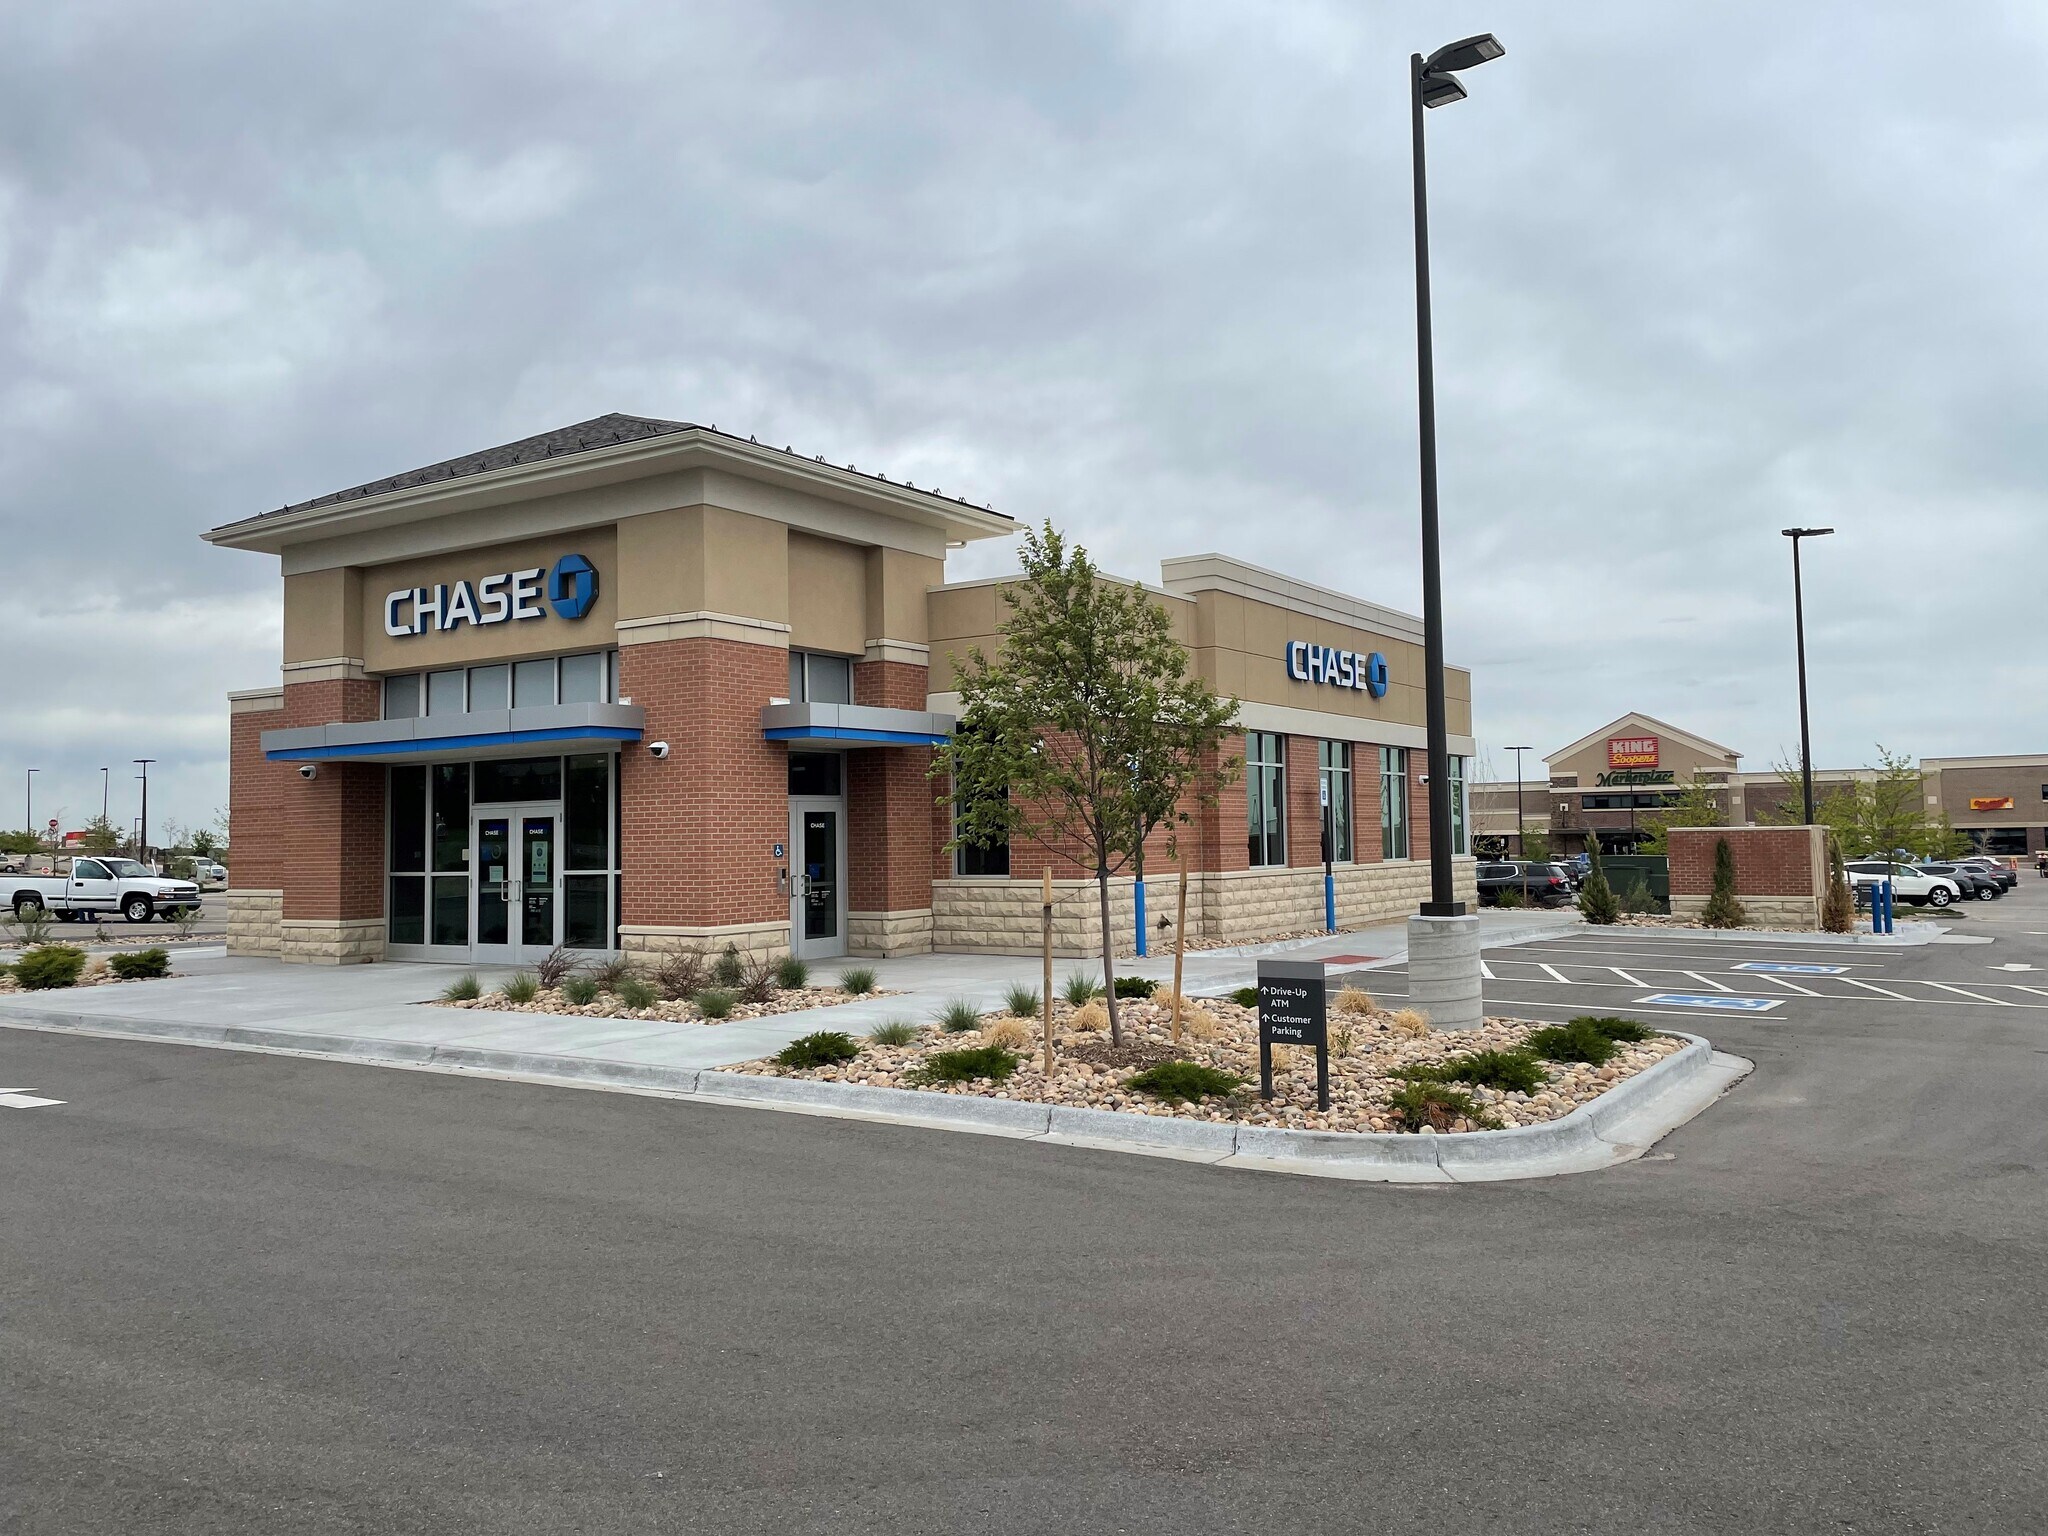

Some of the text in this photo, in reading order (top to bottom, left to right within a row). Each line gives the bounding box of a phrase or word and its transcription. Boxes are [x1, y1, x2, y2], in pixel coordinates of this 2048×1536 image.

[384, 568, 546, 636] CHASE
[1286, 640, 1368, 691] CHASE
[1612, 740, 1654, 753] KING
[1612, 753, 1655, 766] Soopers
[1270, 987, 1307, 998] Drive-Up
[1270, 999, 1289, 1007] ATM
[1271, 1014, 1311, 1024] Customer
[1271, 1026, 1302, 1038] Parking
